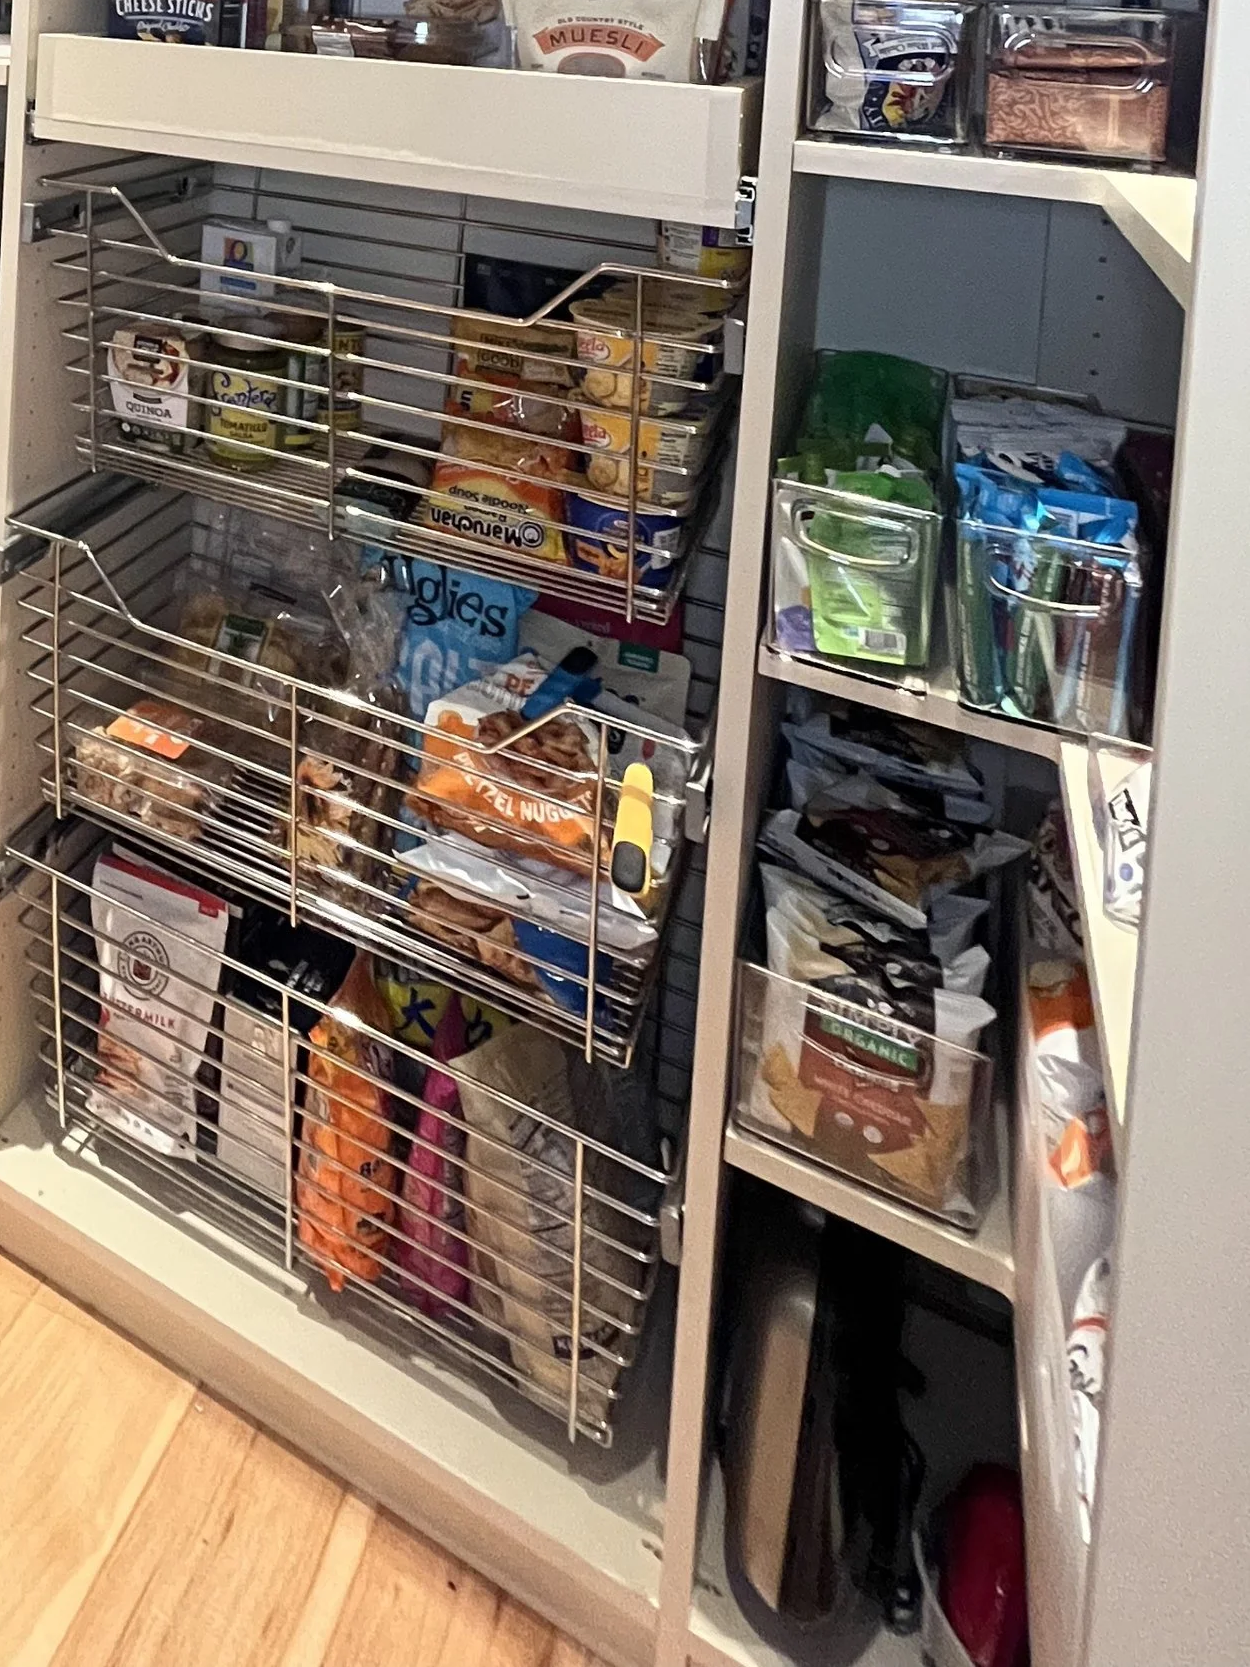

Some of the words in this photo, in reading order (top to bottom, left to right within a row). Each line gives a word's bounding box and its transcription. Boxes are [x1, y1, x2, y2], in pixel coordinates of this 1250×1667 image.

[558, 16, 573, 24] OLD
[576, 16, 615, 24] COUNTRY
[618, 18, 644, 30] STYLE
[550, 28, 645, 55] MUESLI
[126, 401, 172, 420] QUINOA
[448, 485, 479, 503] Soup
[482, 494, 528, 514] Noodle
[430, 507, 521, 547] Maruchan
[830, 1021, 909, 1066] ORGANIC
